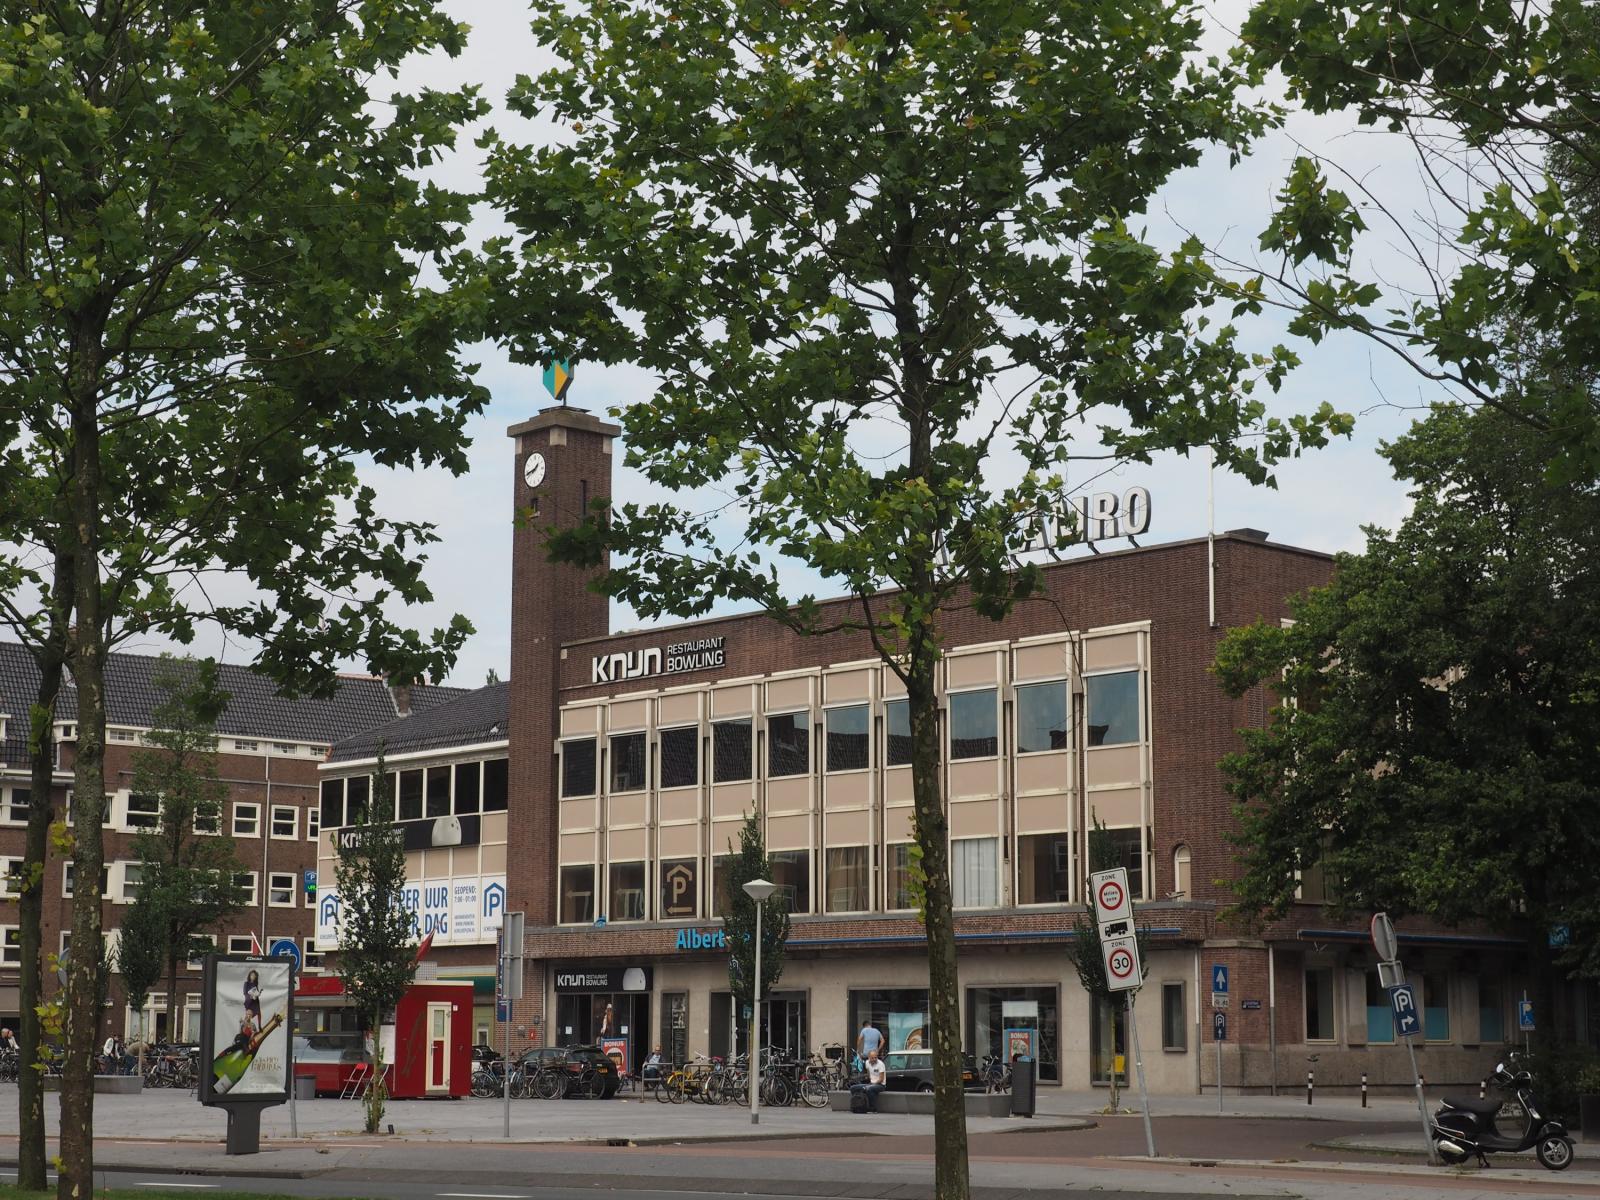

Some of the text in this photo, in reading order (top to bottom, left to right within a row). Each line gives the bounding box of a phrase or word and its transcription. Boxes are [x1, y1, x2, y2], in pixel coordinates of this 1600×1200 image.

[667, 636, 725, 656] RESTAURANT
[667, 649, 724, 673] BOWLING
[1101, 873, 1116, 881] ZONE
[425, 886, 449, 909] UUR
[454, 885, 477, 895] GEOPEND:
[673, 876, 687, 904] P
[425, 912, 448, 935] DAG
[676, 927, 725, 950] Albert
[1111, 940, 1127, 948] ZONE
[1113, 957, 1130, 970] 30
[586, 979, 608, 987] BOWLING
